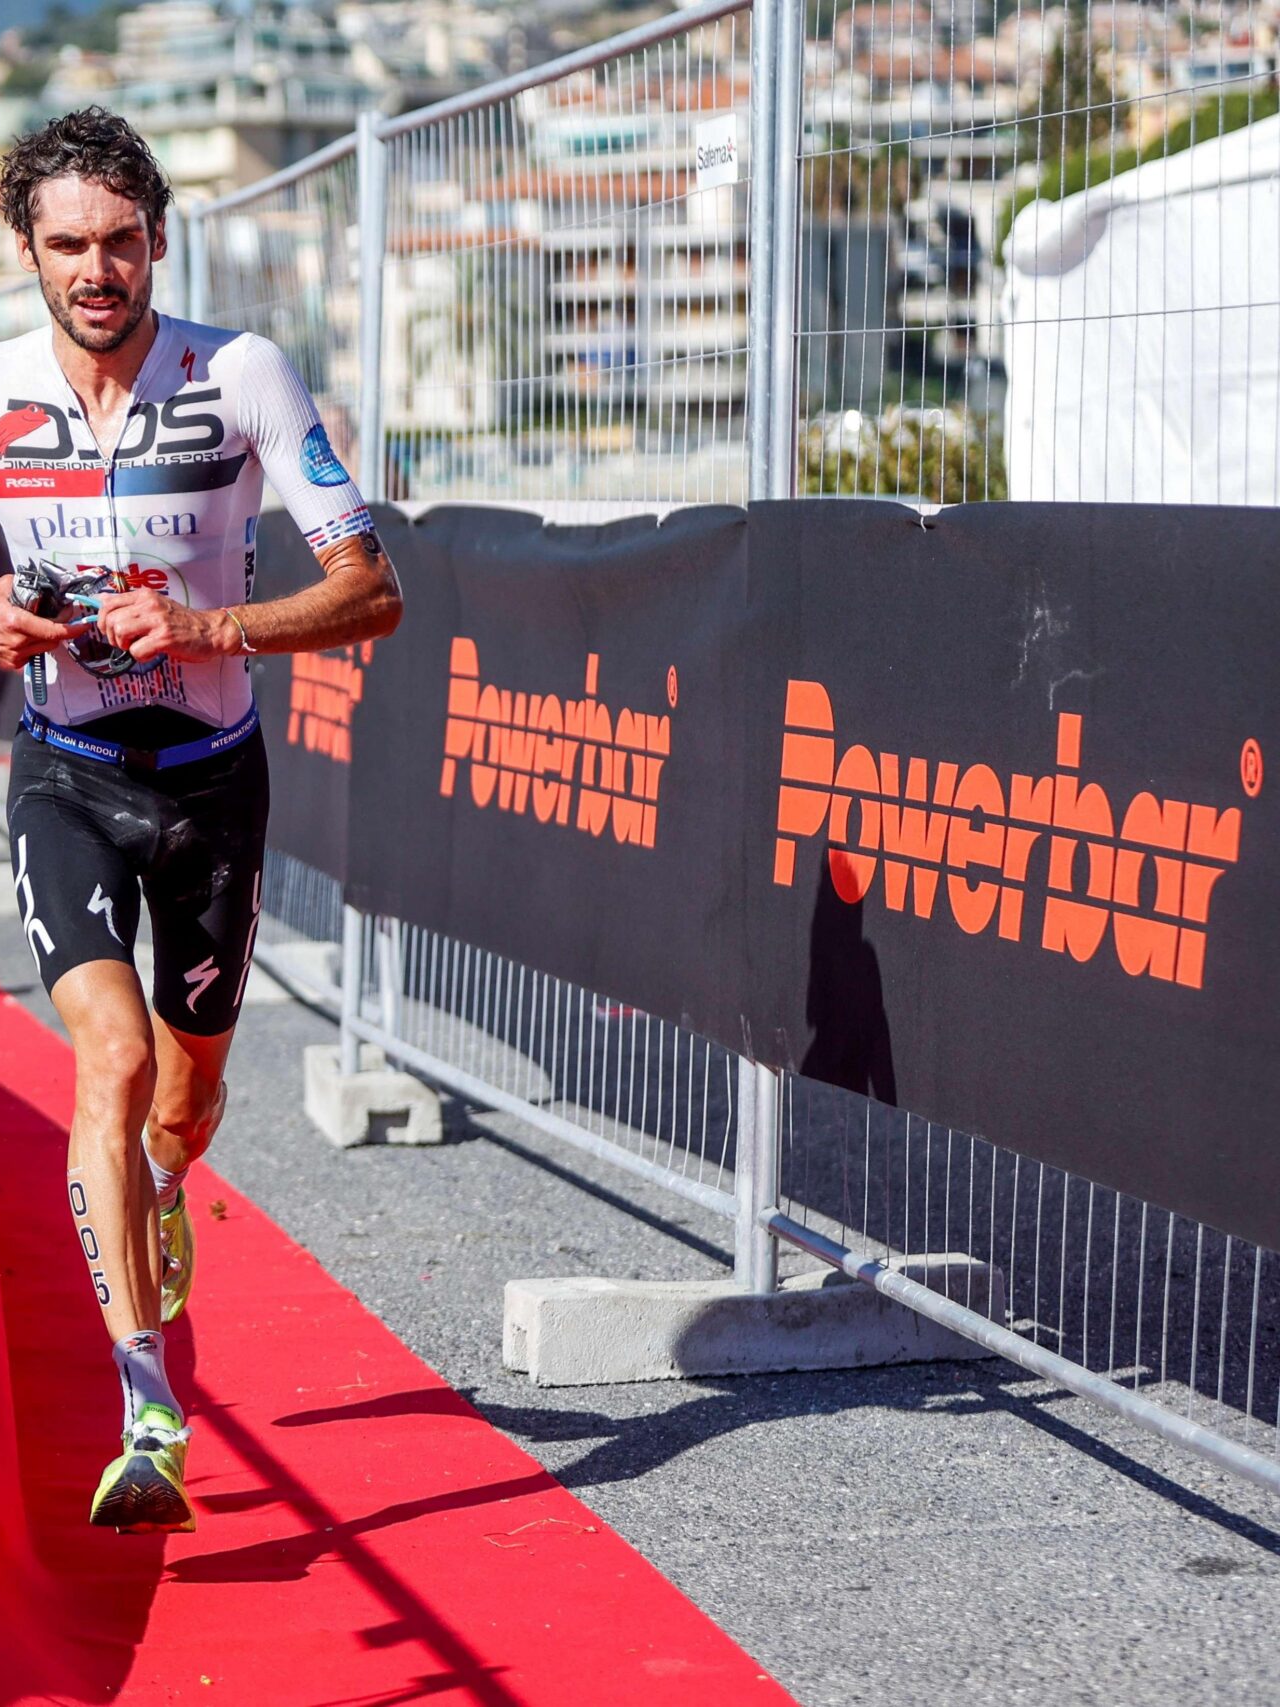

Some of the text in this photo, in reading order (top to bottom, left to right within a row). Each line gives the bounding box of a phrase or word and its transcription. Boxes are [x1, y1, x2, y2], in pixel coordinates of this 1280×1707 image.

[697, 138, 736, 171] Safemax
[4, 460, 104, 470] DIMENSIONE
[170, 451, 223, 465] SPORT
[26, 503, 200, 549] planven
[33, 723, 125, 763] TRATHLON BARDOLI
[439, 636, 671, 849] Powerbar
[773, 679, 1242, 989] Powerbar
[69, 1181, 111, 1306] 005
